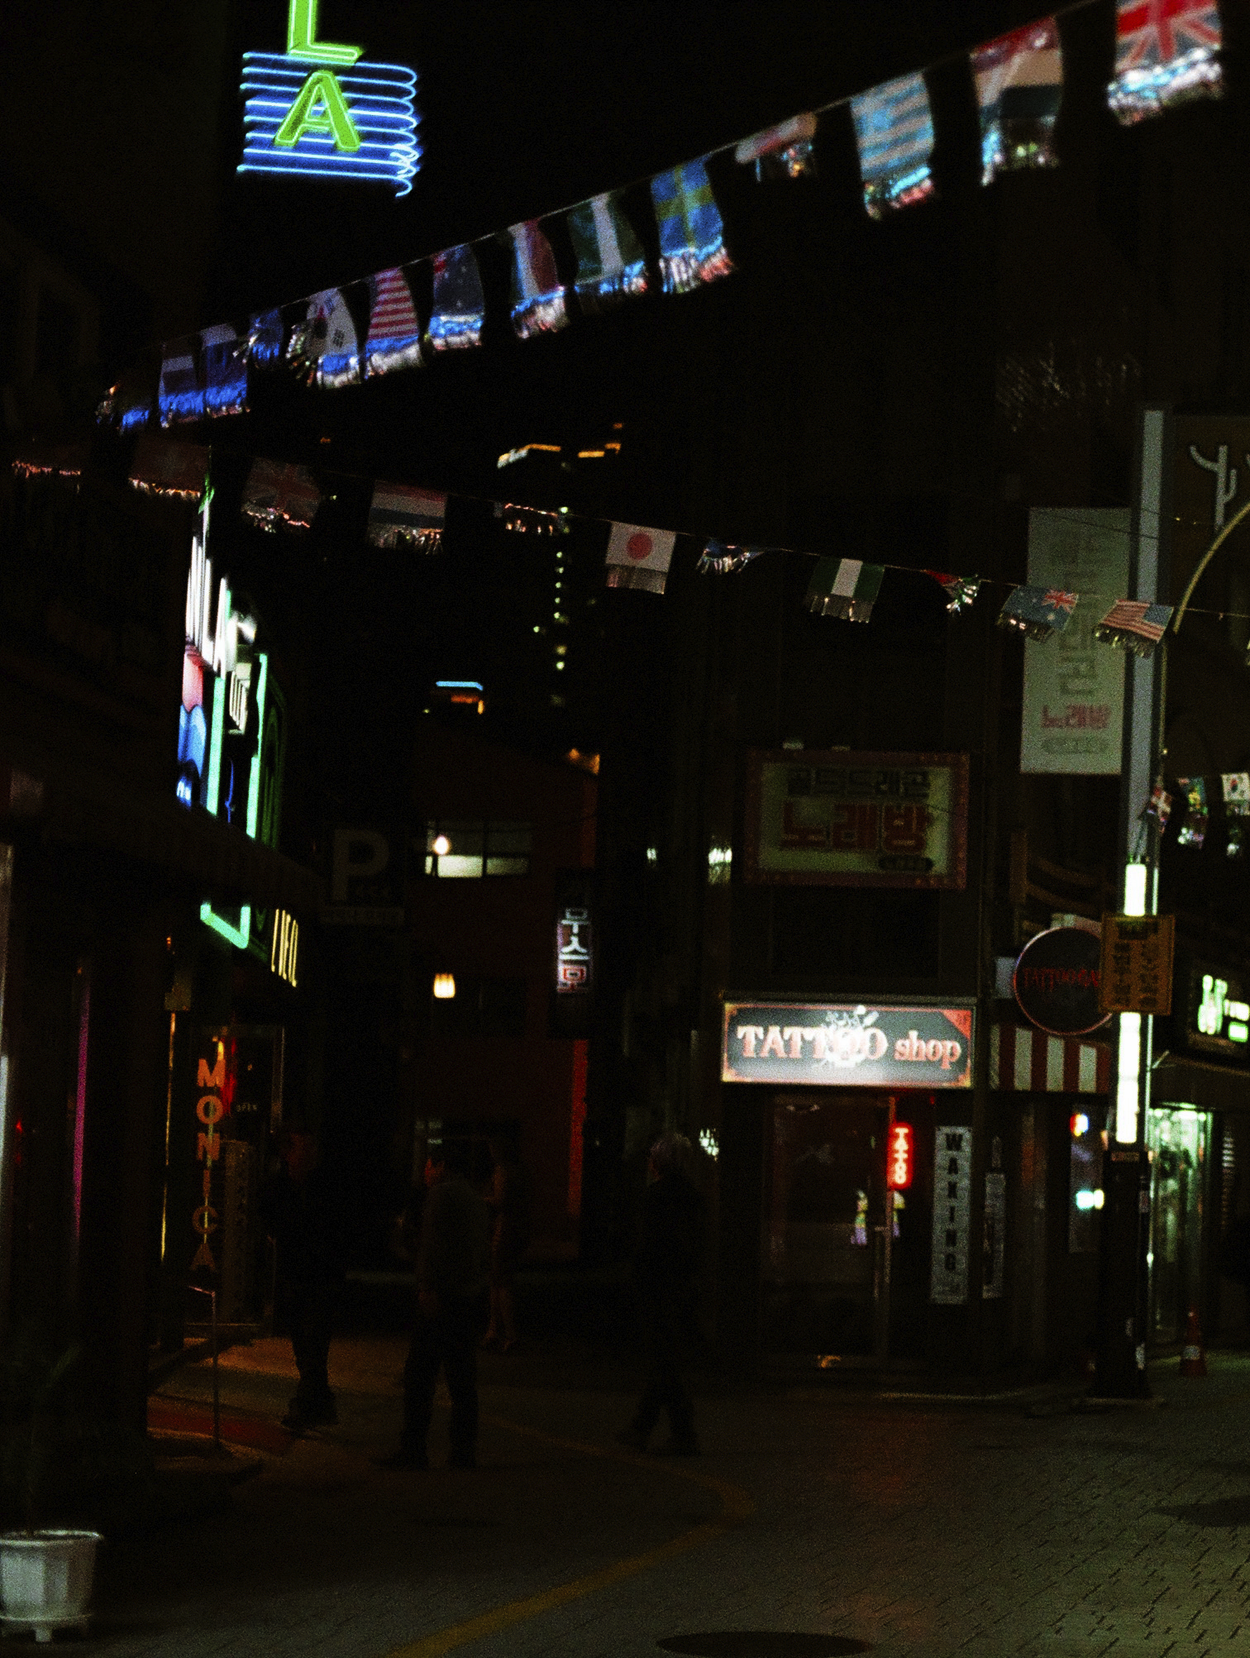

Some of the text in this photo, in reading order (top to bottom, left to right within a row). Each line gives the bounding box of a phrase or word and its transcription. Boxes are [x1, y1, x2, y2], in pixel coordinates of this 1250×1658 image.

[779, 801, 933, 851] 노래방
[737, 1024, 962, 1070] TATTOO shop
[189, 1057, 226, 1272] MONICA
[944, 1132, 964, 1272] WAXING
